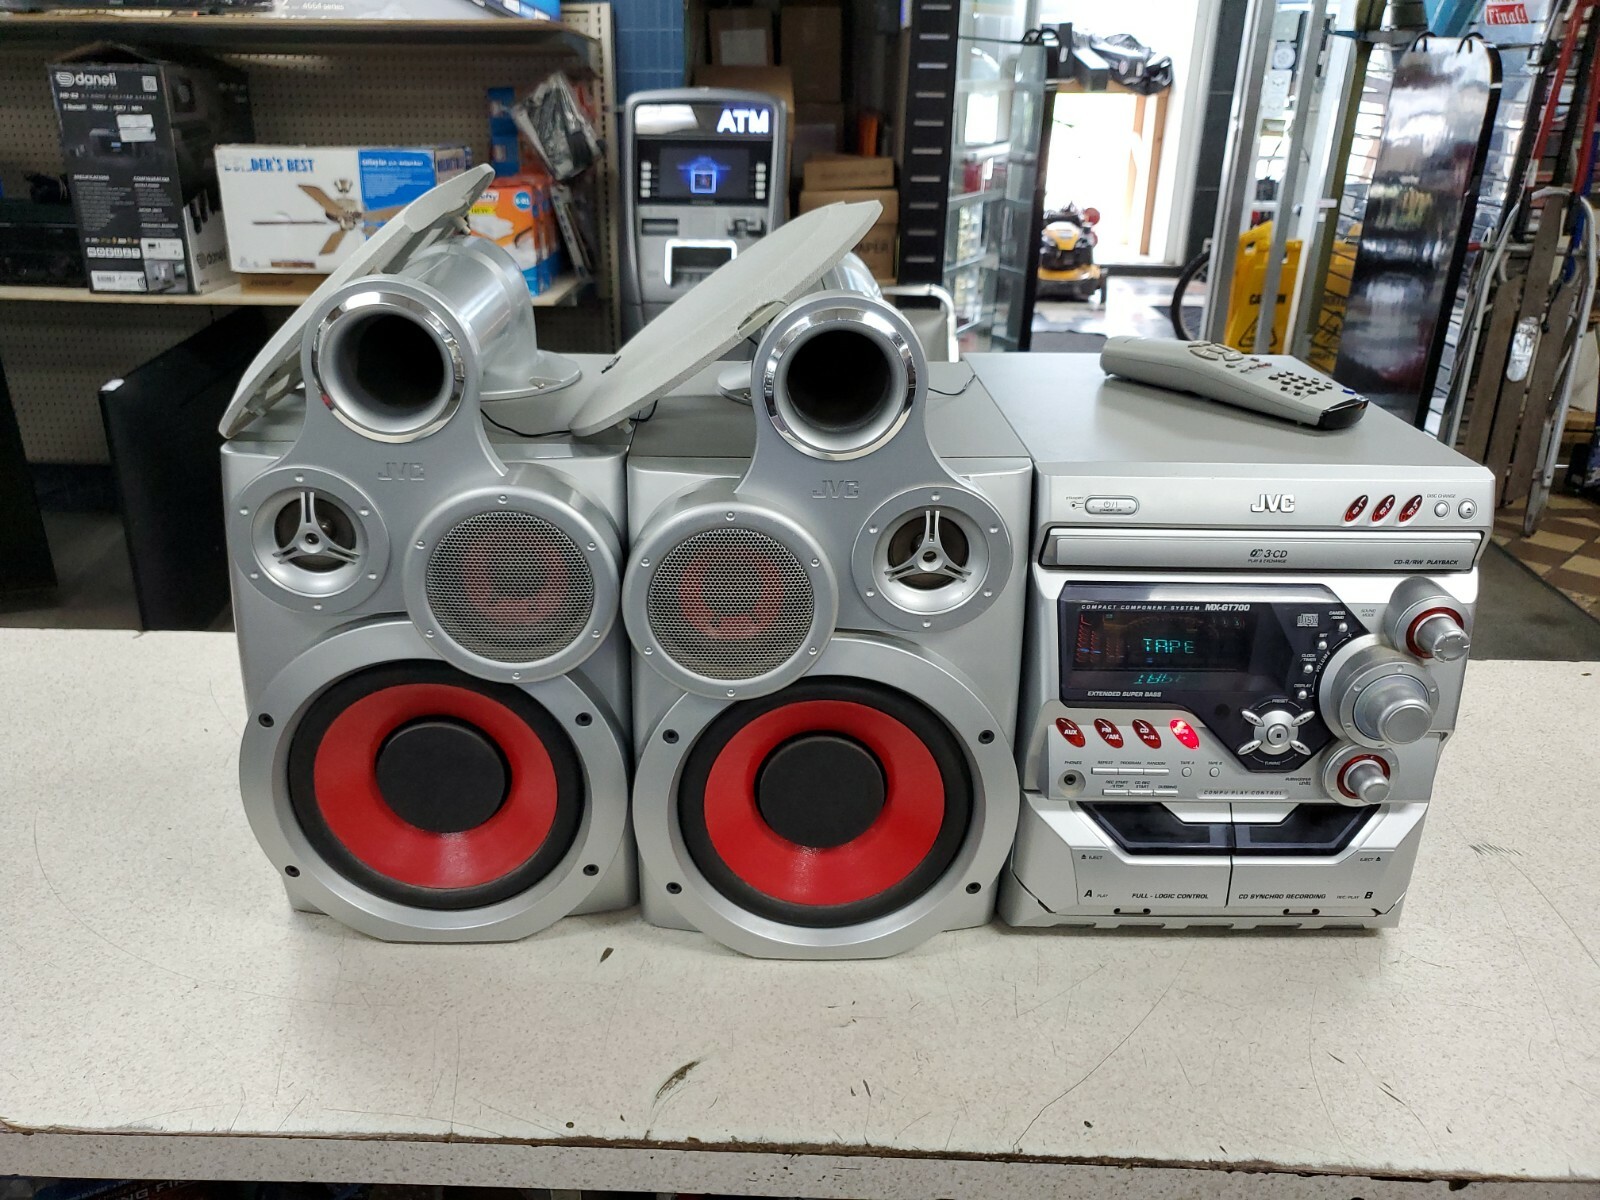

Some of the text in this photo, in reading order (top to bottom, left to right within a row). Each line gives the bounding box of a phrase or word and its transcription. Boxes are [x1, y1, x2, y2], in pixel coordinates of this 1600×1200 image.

[1488, 5, 1526, 24] Final!
[716, 108, 770, 134] ATM
[377, 461, 425, 481] JVC
[812, 479, 860, 499] JVC
[1250, 494, 1295, 513] JVC
[1204, 603, 1250, 612] MX-GT700
[1143, 638, 1195, 654] TAPE
[1315, 650, 1331, 673] VOLUME
[1084, 889, 1093, 898] A
[1364, 891, 1374, 900] B
